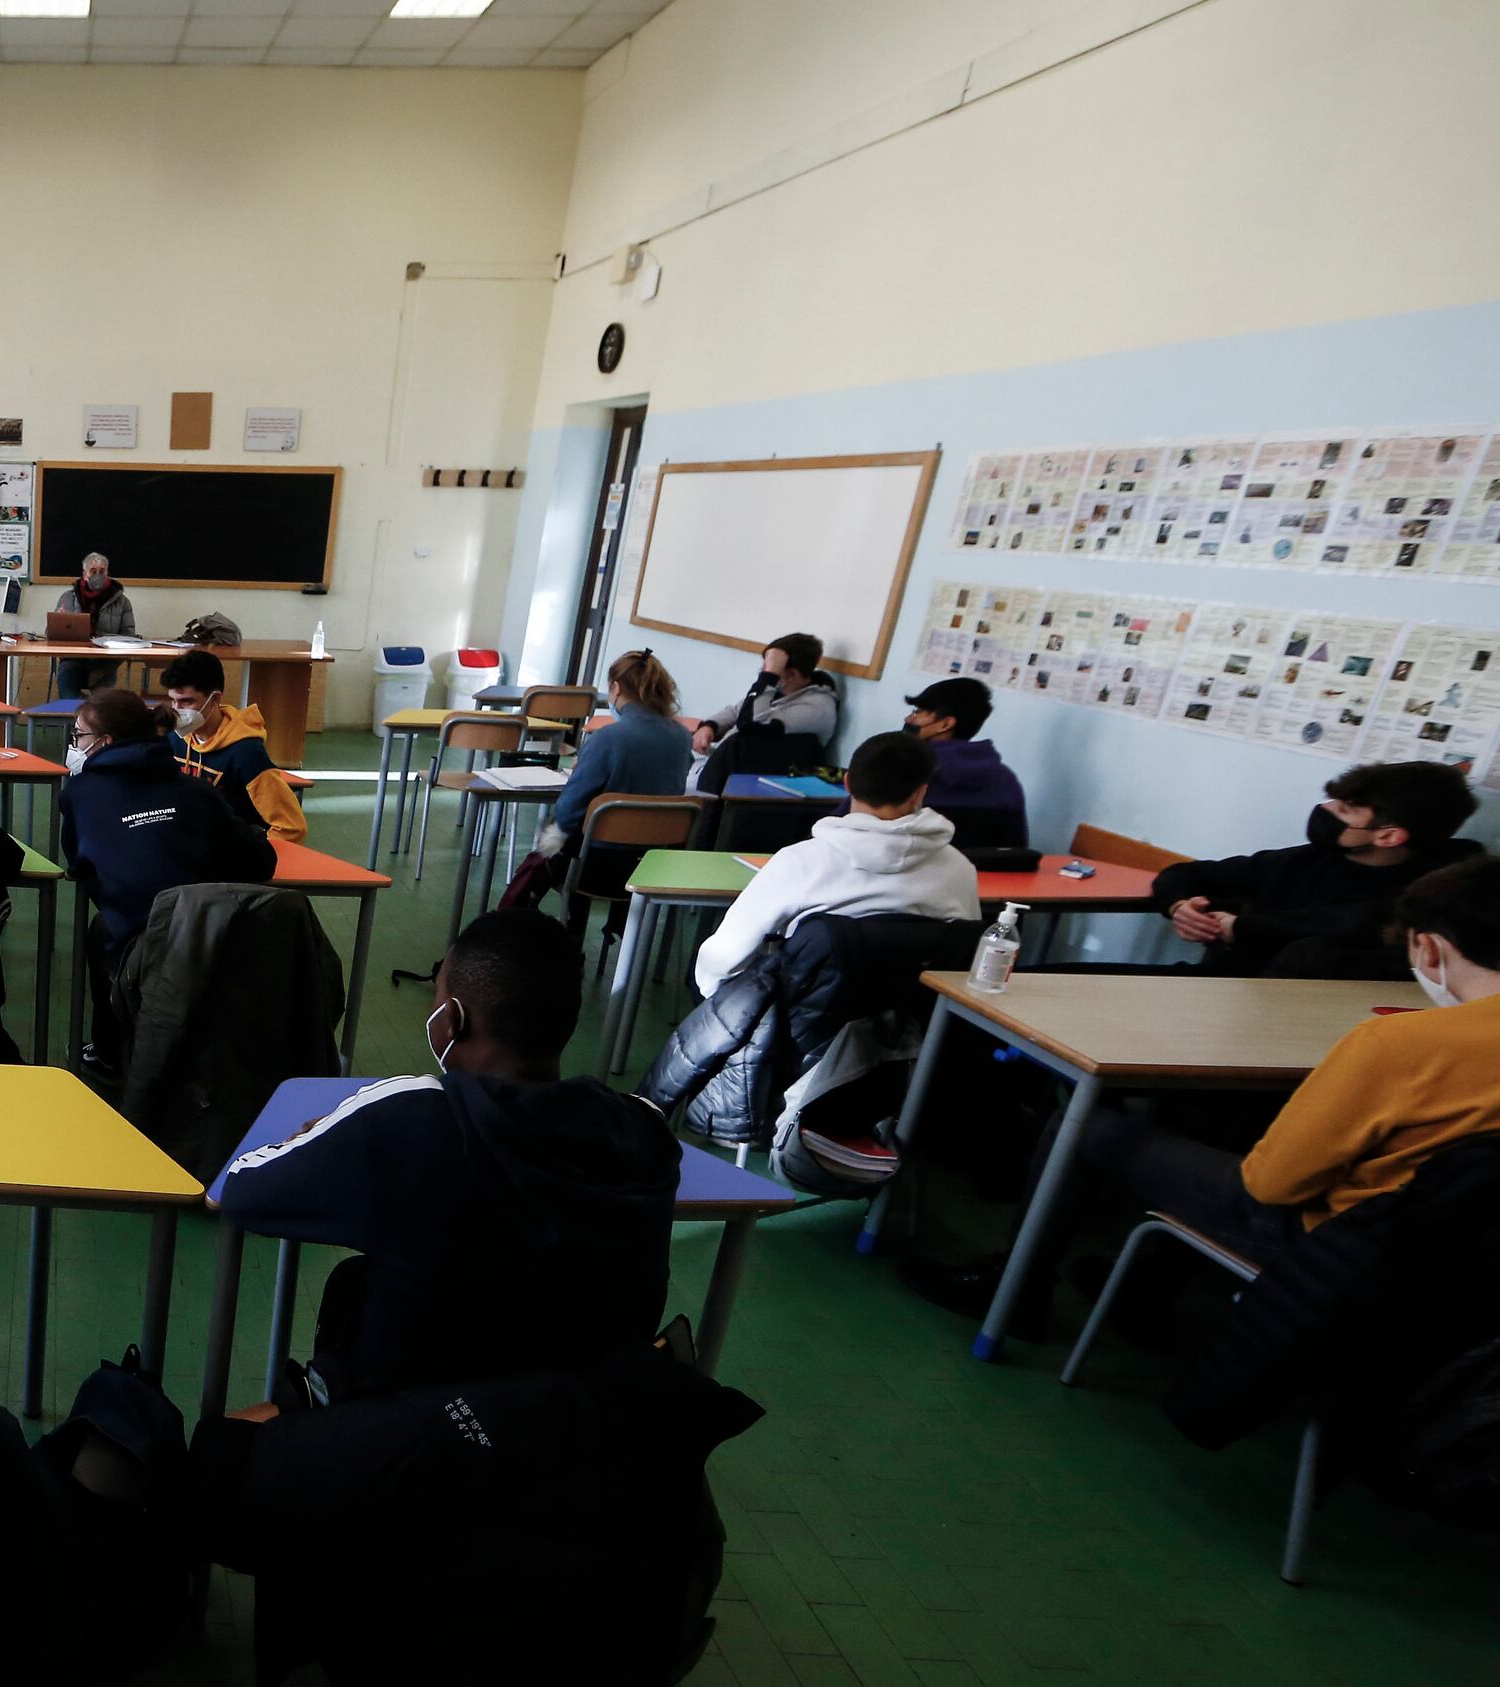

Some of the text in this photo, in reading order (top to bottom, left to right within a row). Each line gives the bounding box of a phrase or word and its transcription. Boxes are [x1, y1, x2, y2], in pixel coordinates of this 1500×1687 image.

[121, 811, 148, 823] NATION
[148, 807, 177, 817] NATURE
[454, 1397, 464, 1406] N
[444, 1403, 454, 1411] E
